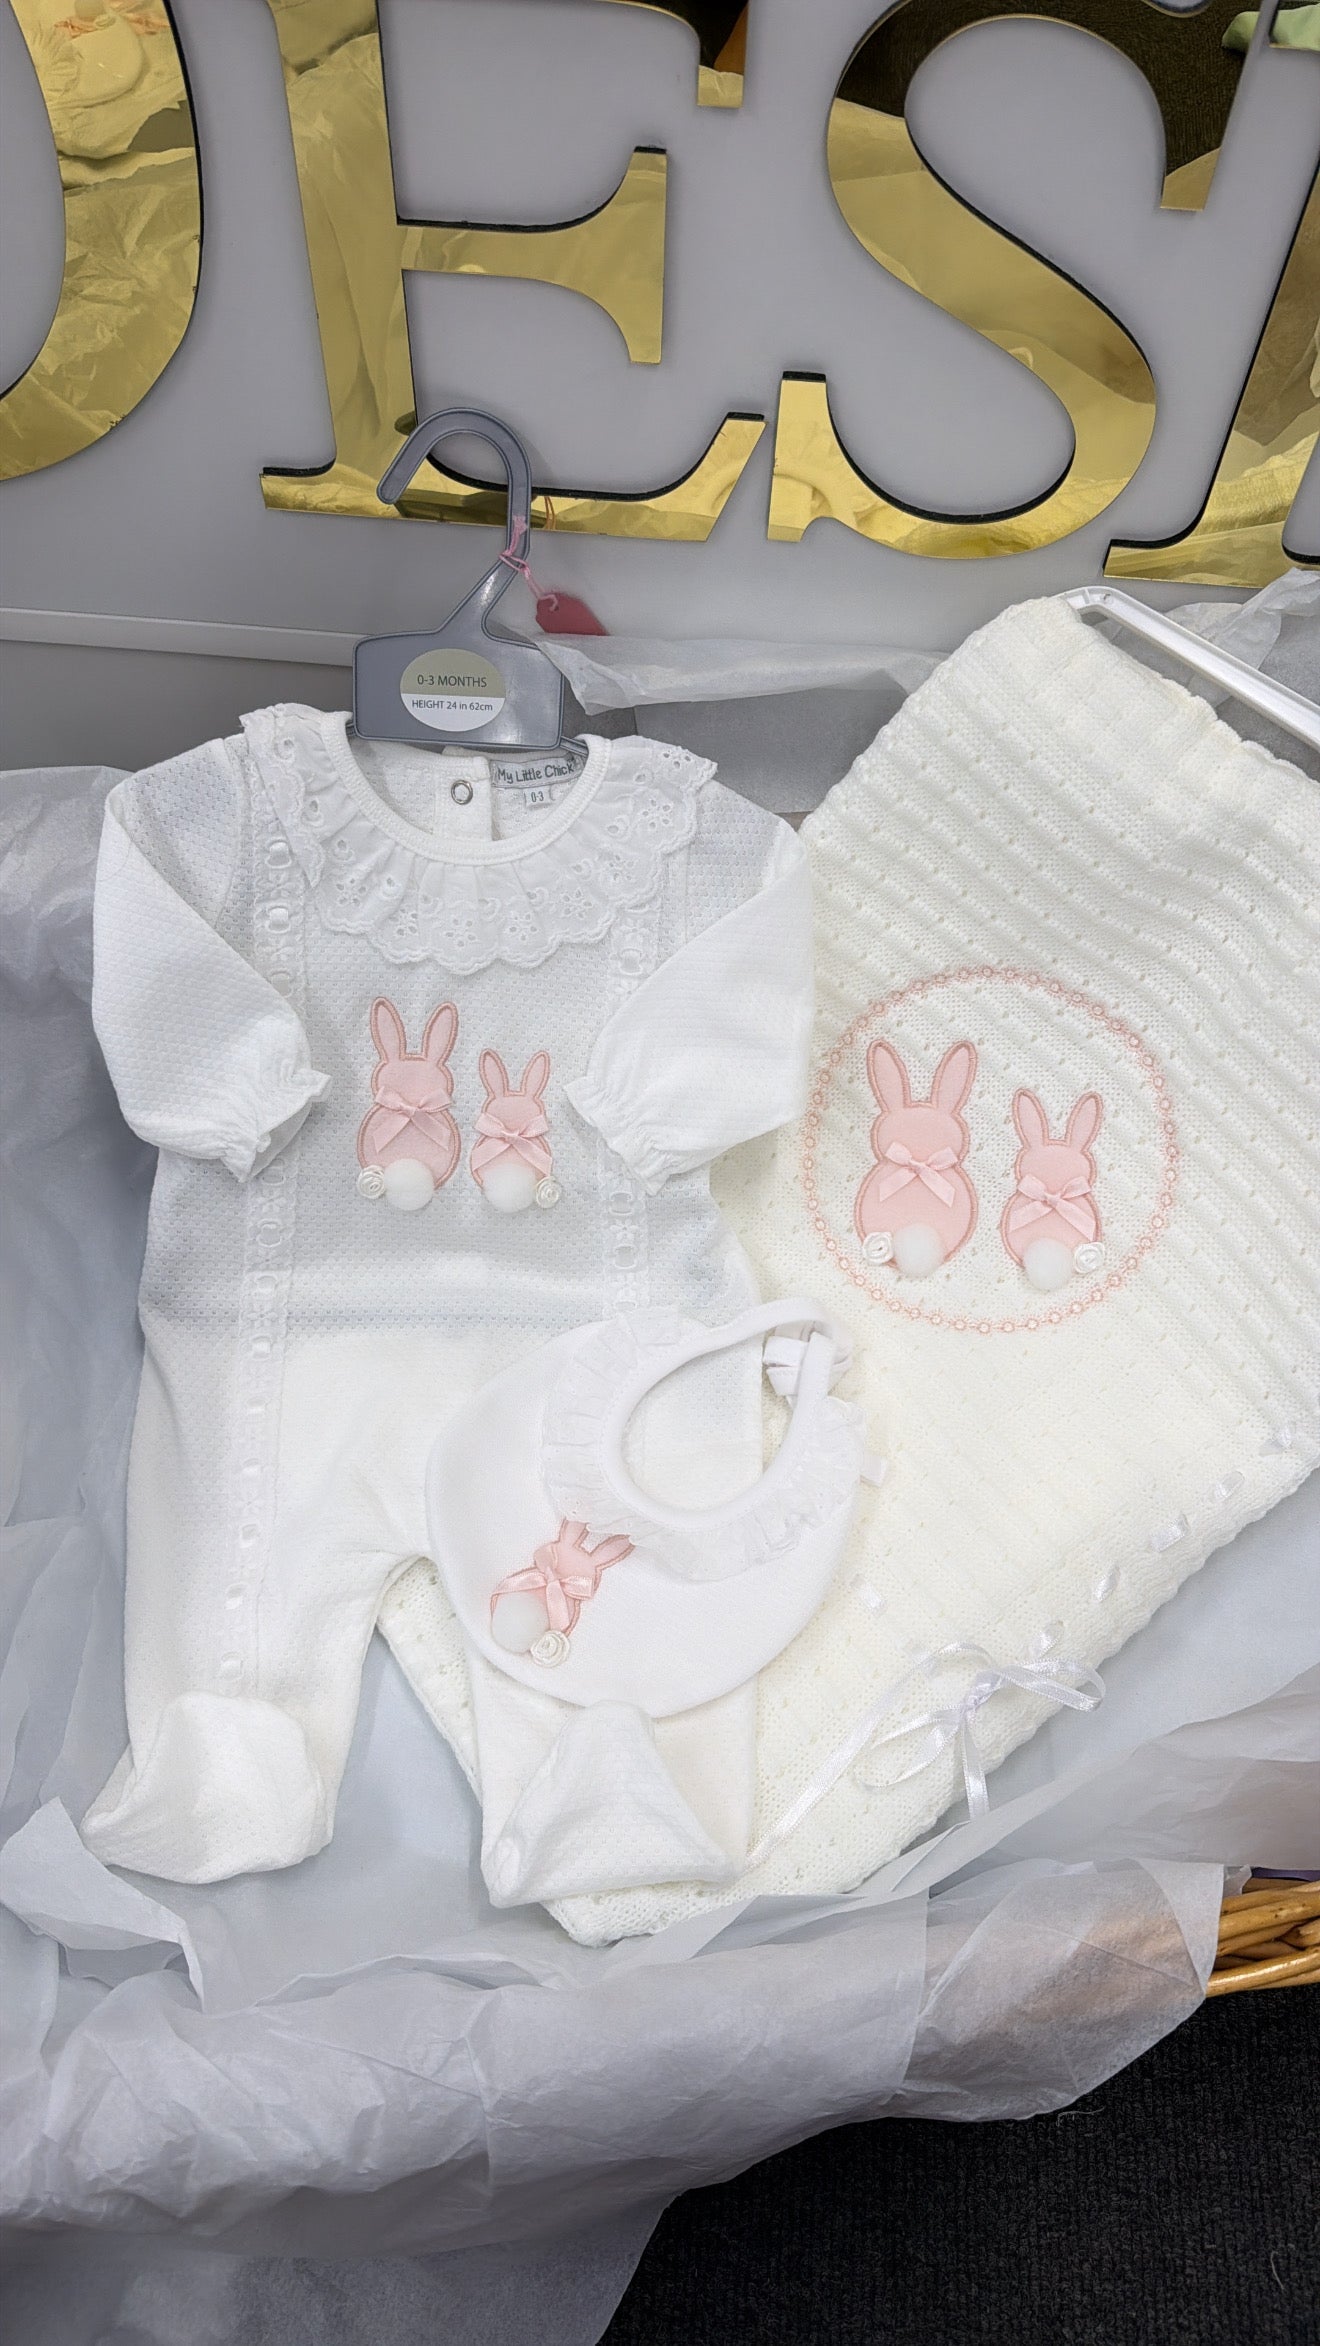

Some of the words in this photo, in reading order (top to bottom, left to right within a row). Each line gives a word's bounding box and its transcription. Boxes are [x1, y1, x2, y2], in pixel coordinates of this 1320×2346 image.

[417, 674, 435, 686] 0-3
[437, 675, 488, 688] MONTHS
[411, 699, 445, 710] HEIGHT
[446, 701, 457, 710] 24
[459, 702, 468, 711] in
[469, 702, 493, 711] 62cm
[497, 767, 514, 784] My
[515, 767, 543, 782] Little
[544, 762, 575, 778] Chick
